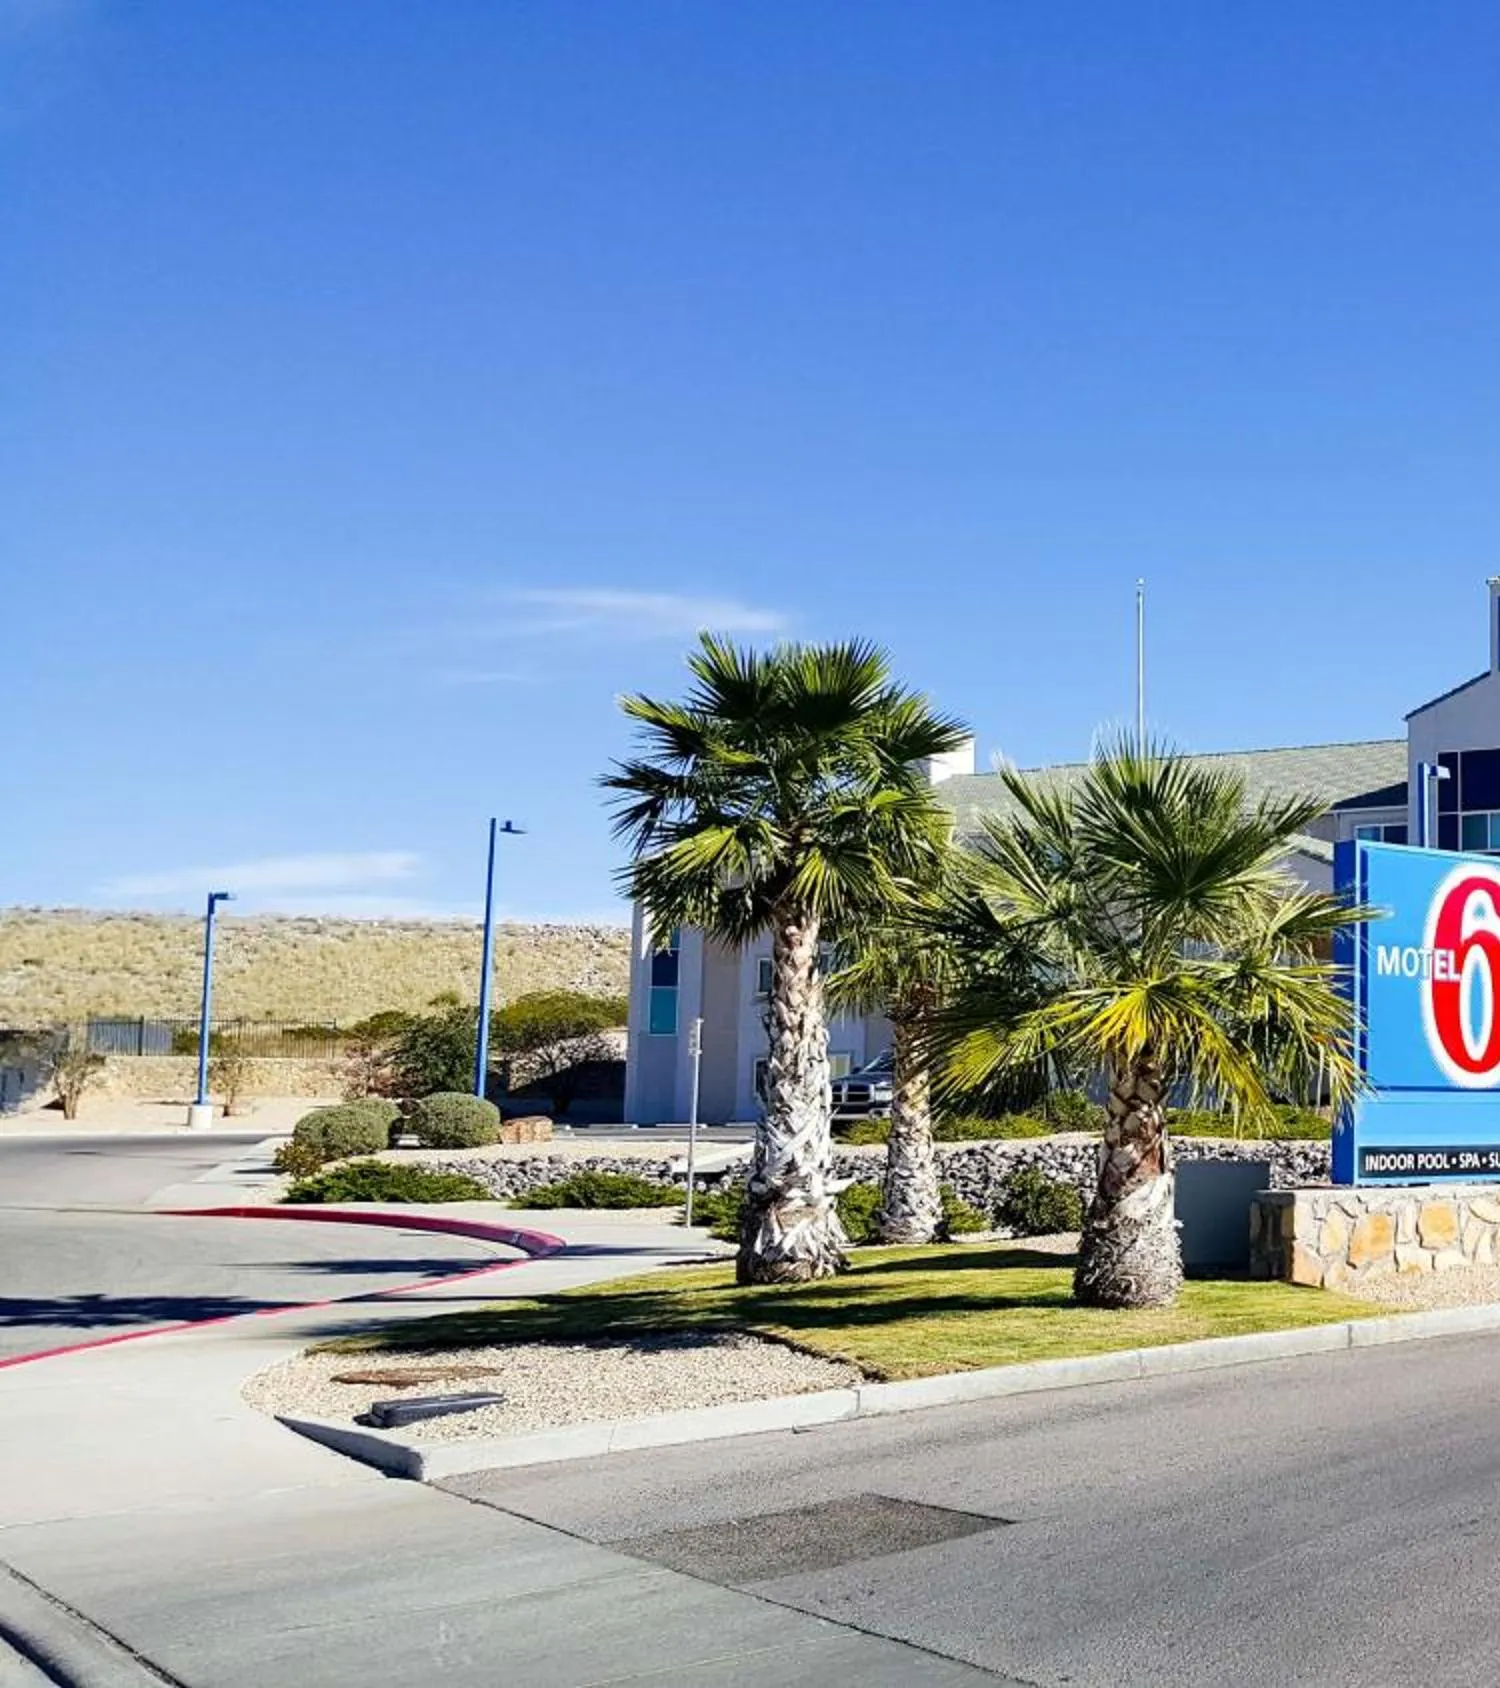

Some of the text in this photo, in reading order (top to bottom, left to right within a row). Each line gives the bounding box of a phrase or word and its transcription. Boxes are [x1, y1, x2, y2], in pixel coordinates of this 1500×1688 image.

[1377, 945, 1462, 980] MOTEL
[1365, 1153, 1415, 1171] INDOOR
[1417, 1152, 1450, 1169] POOL
[1459, 1152, 1481, 1169] SPA
